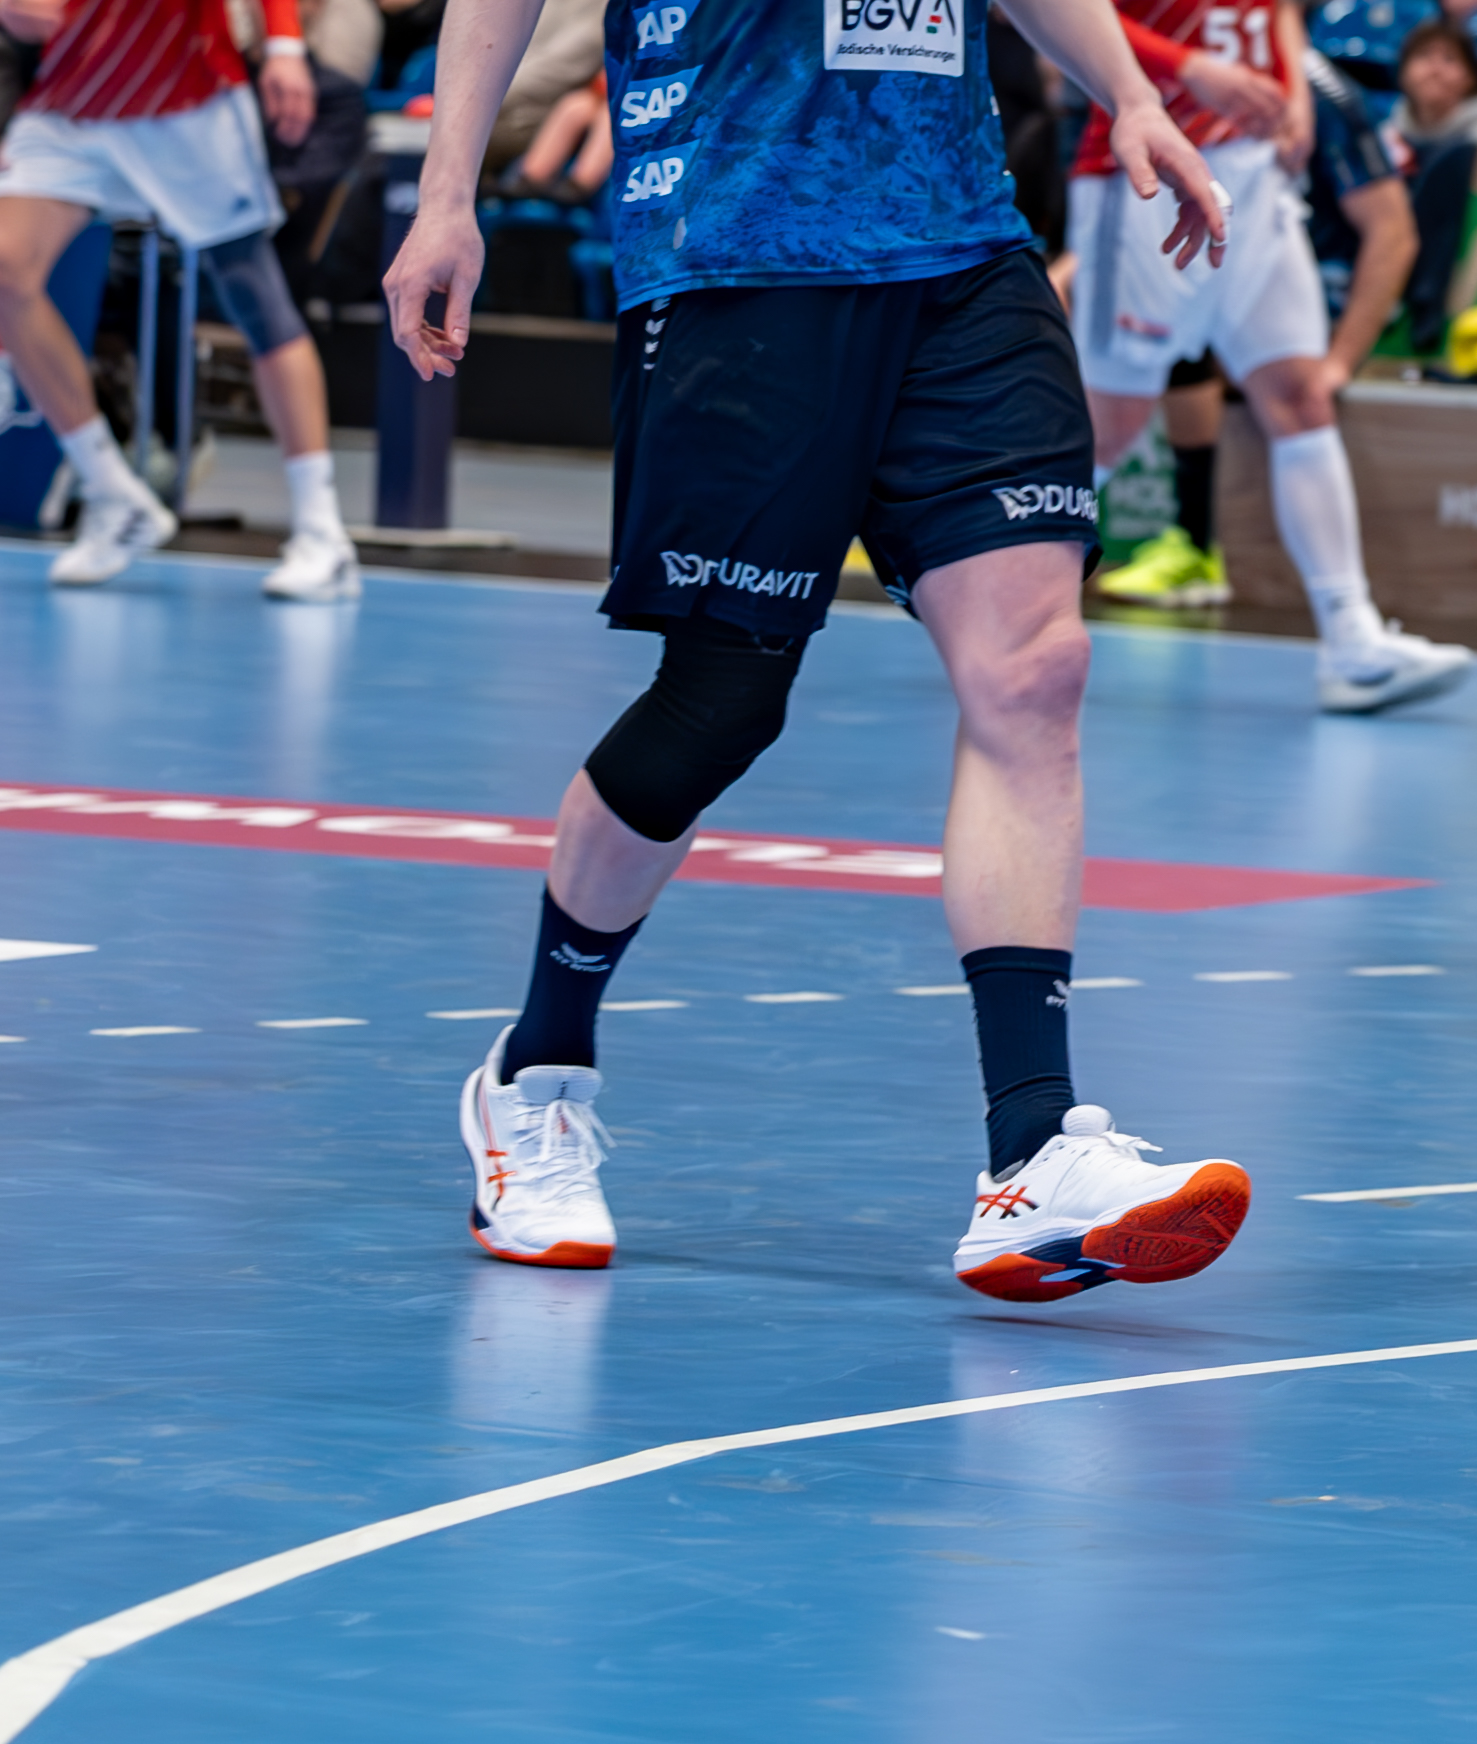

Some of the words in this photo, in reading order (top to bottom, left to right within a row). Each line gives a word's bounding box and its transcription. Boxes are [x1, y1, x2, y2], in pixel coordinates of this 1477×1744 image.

[1202, 6, 1272, 70] 51
[620, 82, 687, 128] SAP
[621, 157, 684, 203] SAP
